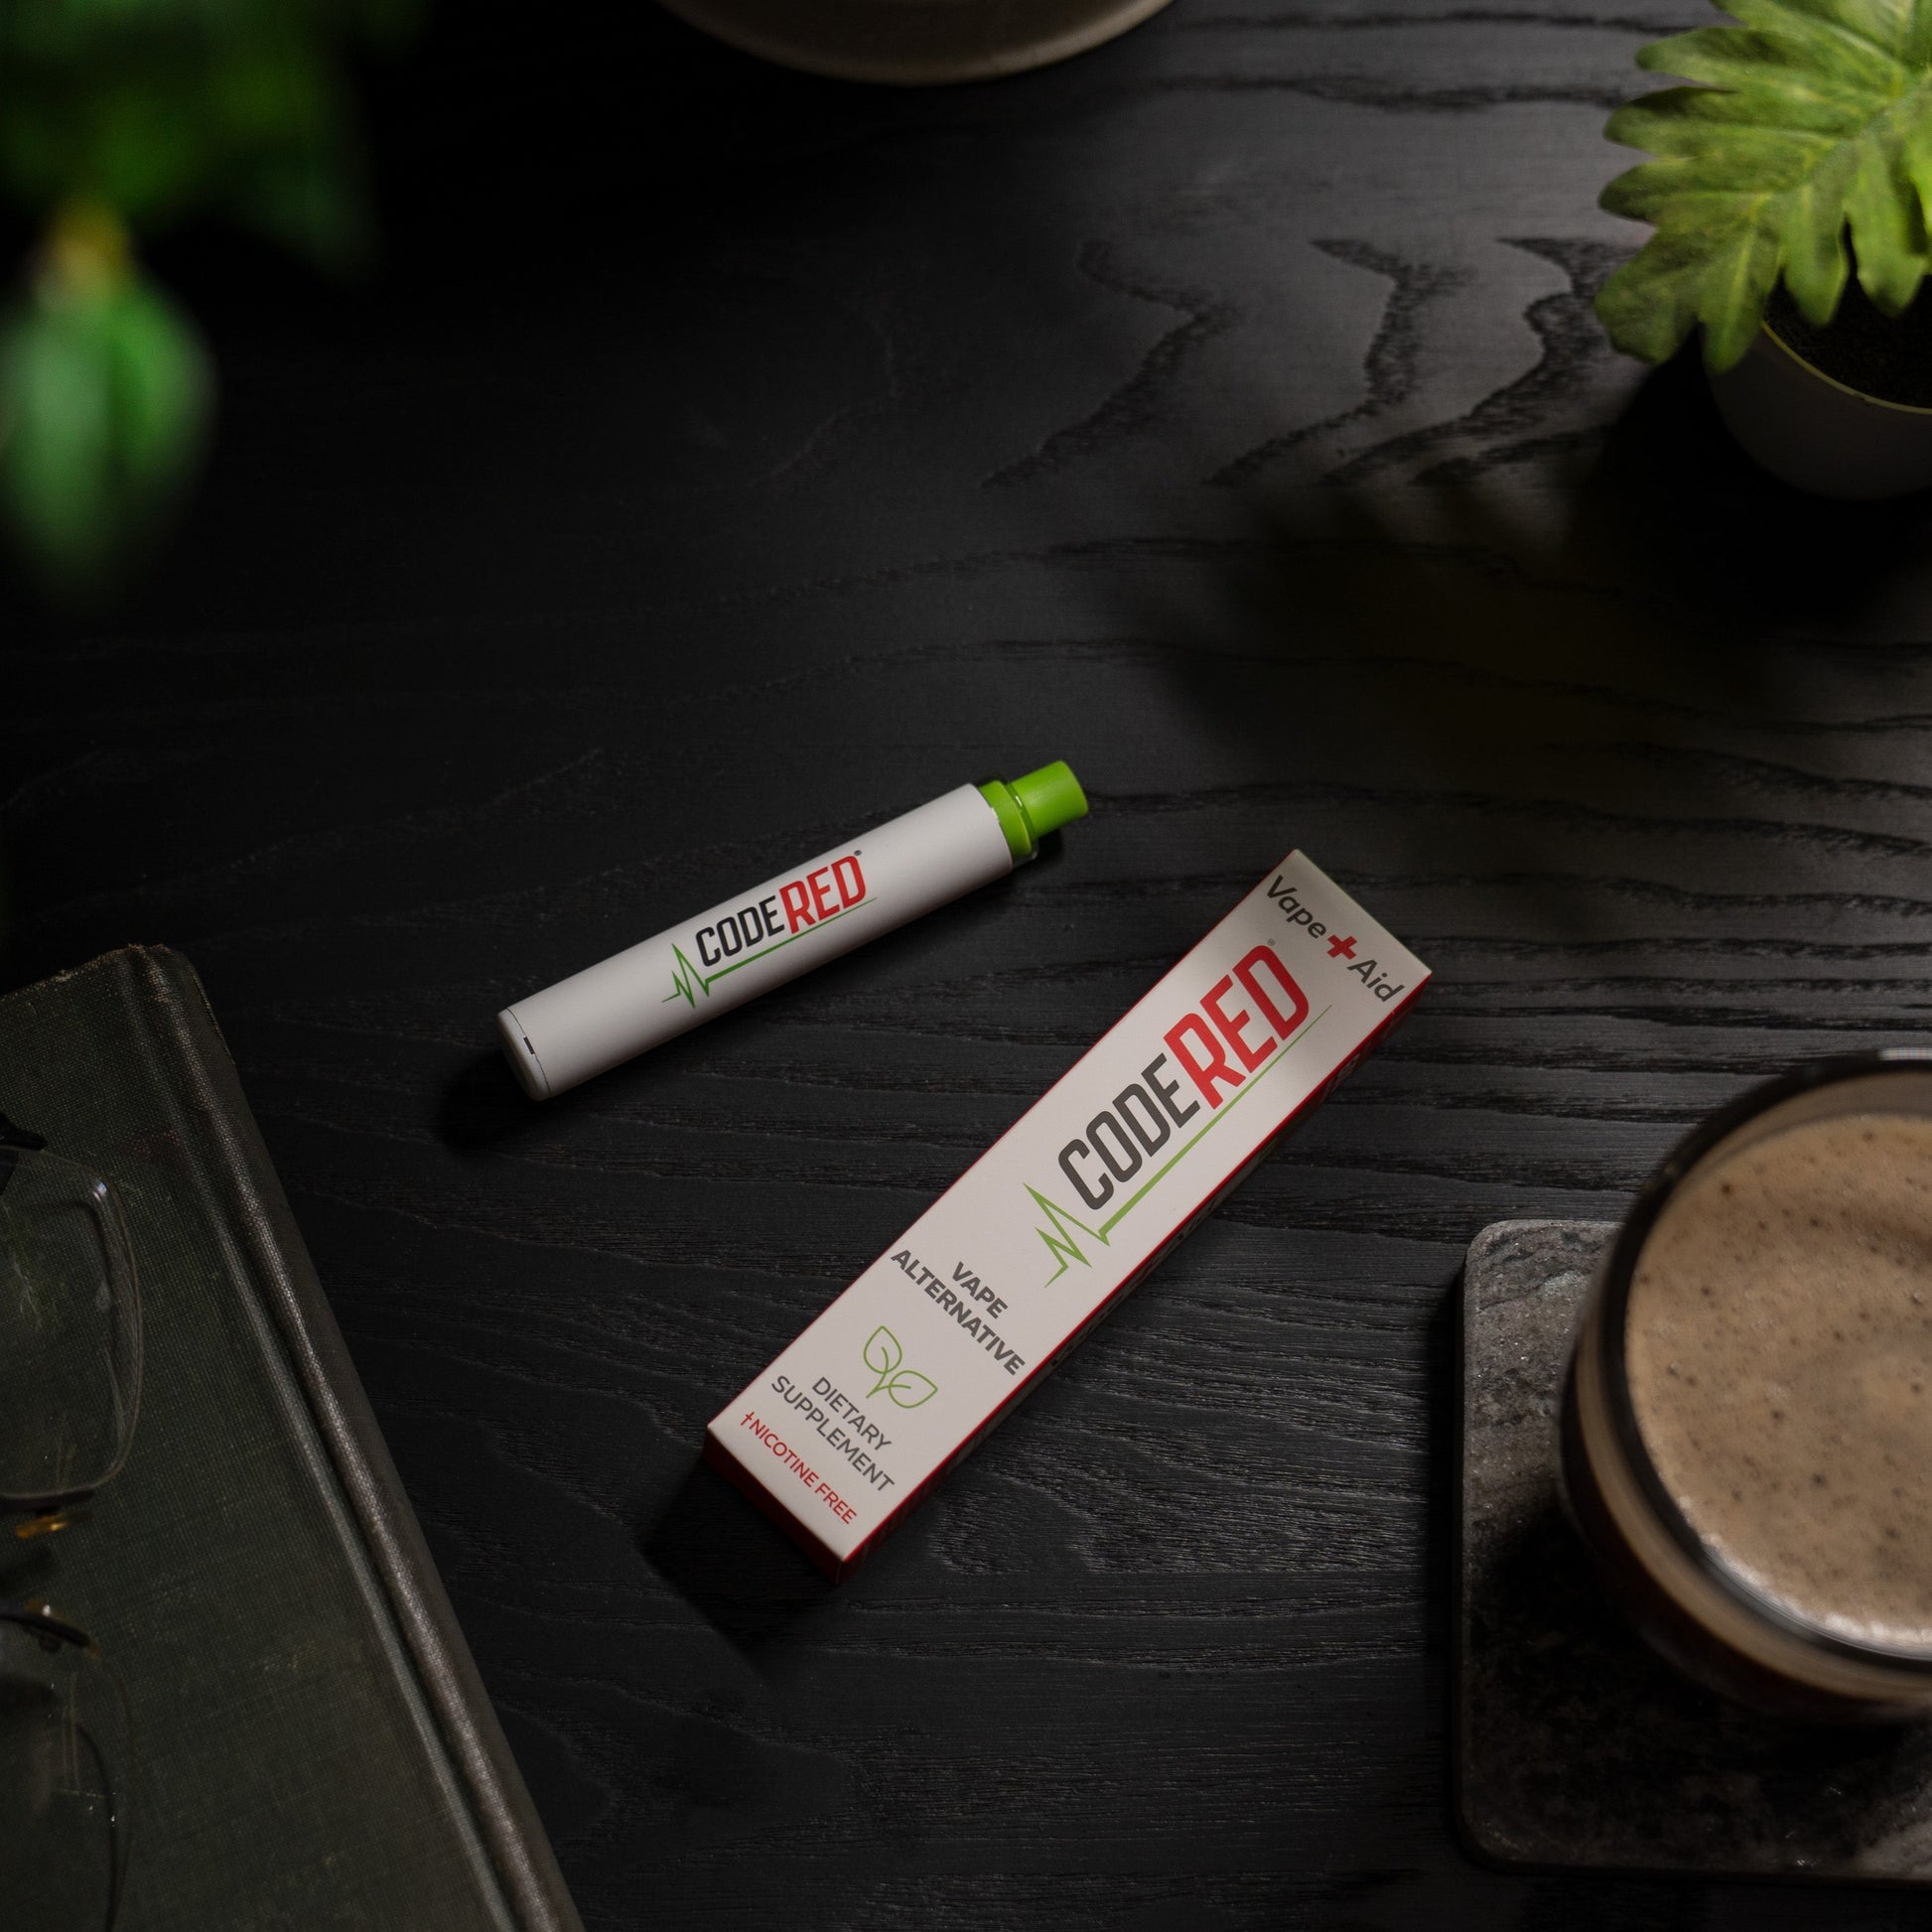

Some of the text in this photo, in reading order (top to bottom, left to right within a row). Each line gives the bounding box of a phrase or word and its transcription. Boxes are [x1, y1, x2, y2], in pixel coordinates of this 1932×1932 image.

[1266, 876, 1405, 1003] Vape Aid
[891, 1250, 1026, 1375] ALTERNATIVE
[952, 1261, 1008, 1318] VAPE
[771, 1375, 895, 1491] SUPPLEMENT
[812, 1377, 892, 1450] DIETARY
[815, 1483, 857, 1524] FREE
